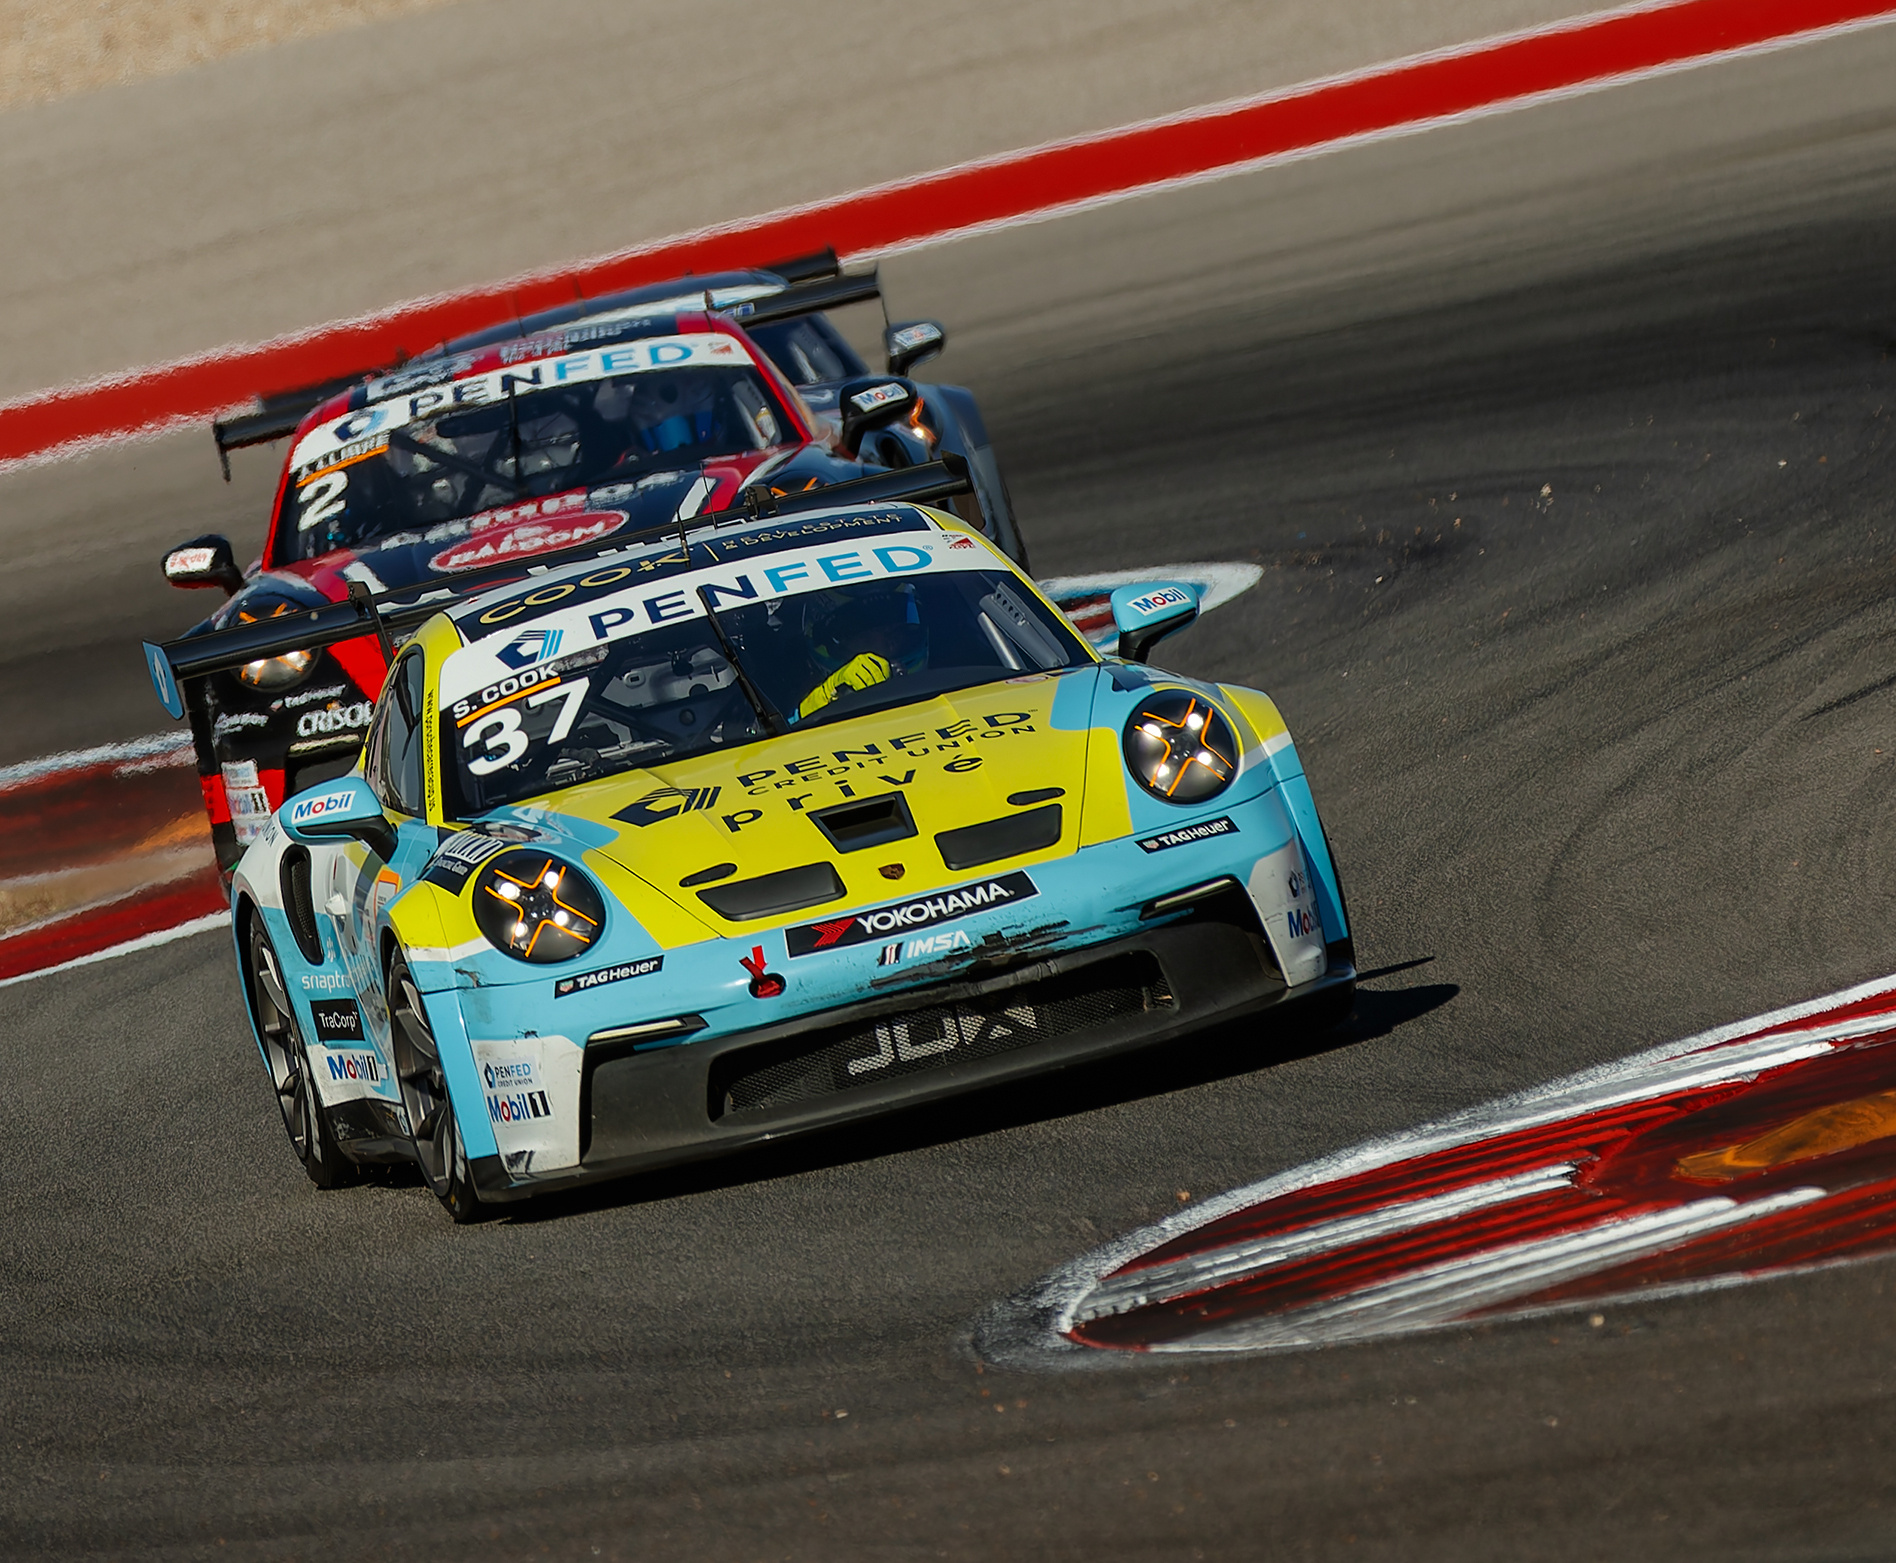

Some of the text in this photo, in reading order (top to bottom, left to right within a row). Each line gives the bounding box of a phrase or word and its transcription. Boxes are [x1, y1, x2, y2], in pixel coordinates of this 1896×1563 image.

[409, 342, 693, 417] PENFED
[298, 470, 348, 530] 2
[744, 515, 902, 547] DEVELOPMENT
[479, 551, 690, 625] COOK
[588, 545, 933, 640] PENFED
[1132, 588, 1188, 613] Mobil
[453, 663, 559, 719] S. COOK
[462, 676, 591, 777] 37
[736, 712, 1032, 788] PENFED
[747, 725, 1036, 796] CREDIT UNION
[294, 794, 352, 820] Mobil
[721, 754, 984, 833] privé
[856, 882, 1010, 934] YOKOHAMA
[906, 930, 971, 958] IMSA
[326, 1054, 369, 1081] Mobil
[494, 1063, 532, 1079] PENFED
[487, 1090, 551, 1123] Mobil 1
